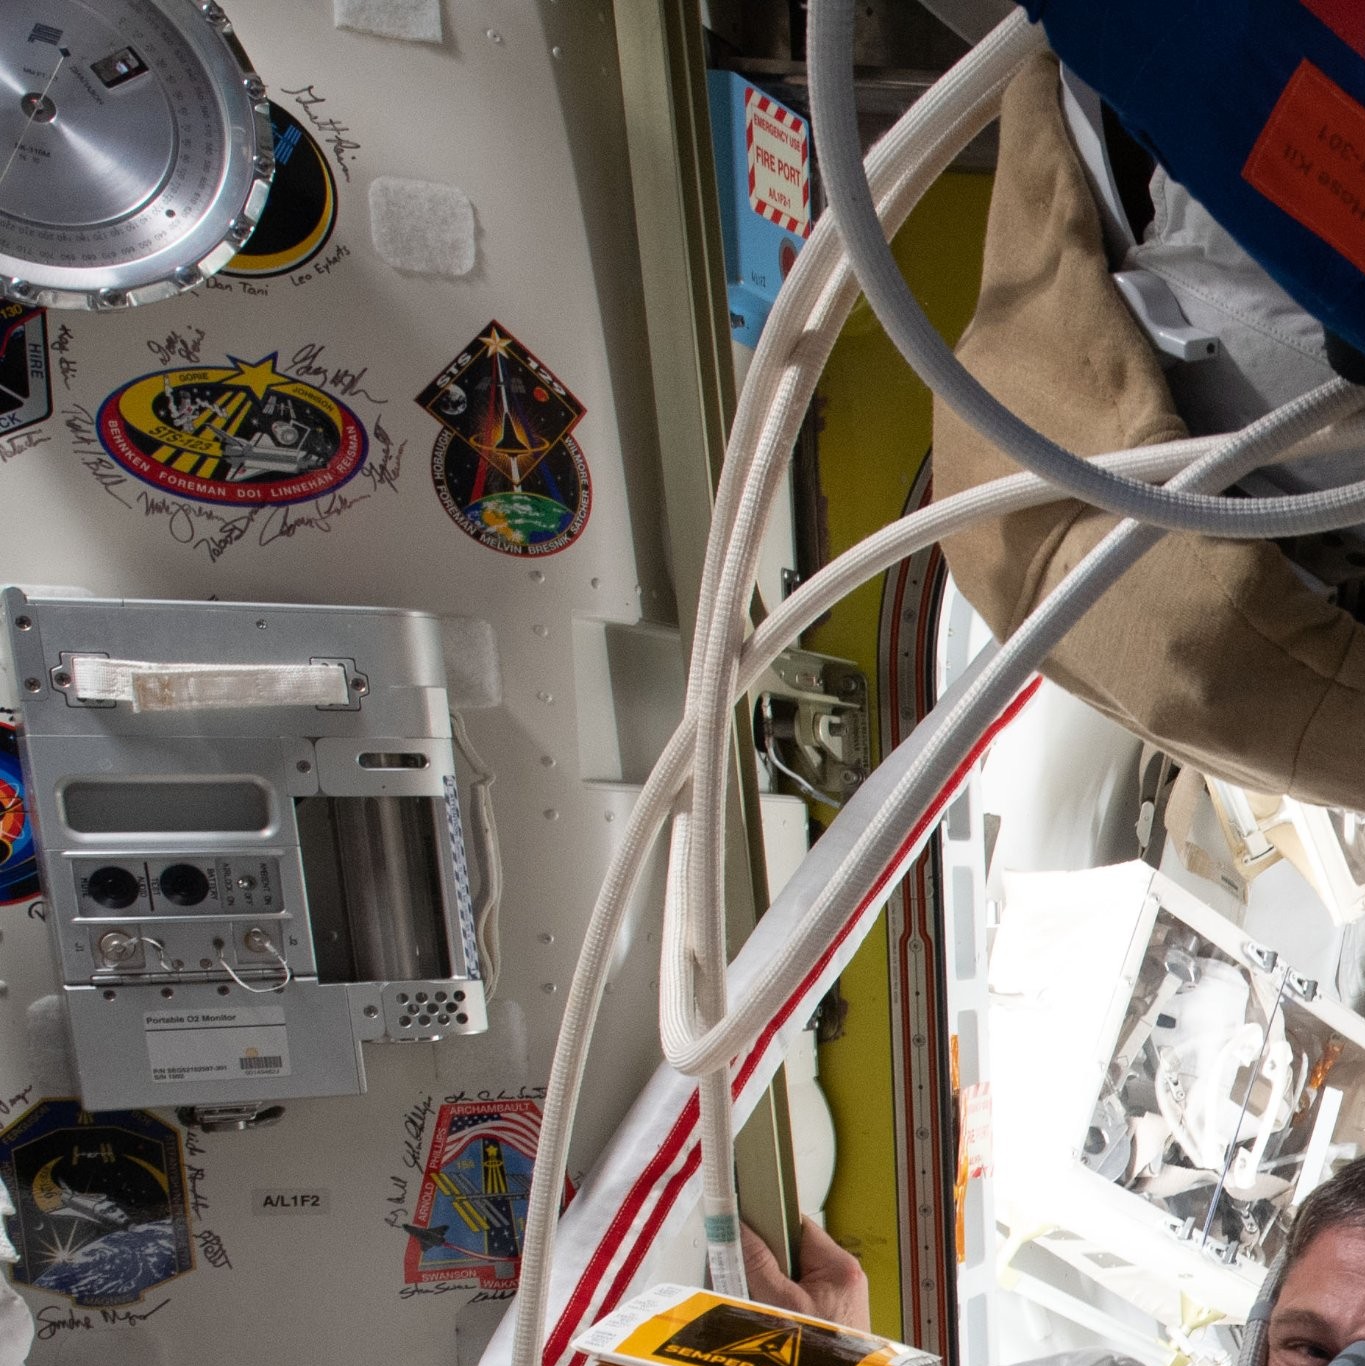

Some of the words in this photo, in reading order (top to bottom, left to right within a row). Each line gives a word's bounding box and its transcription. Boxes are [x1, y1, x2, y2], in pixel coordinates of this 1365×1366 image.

[754, 114, 788, 145] EMERGENCY
[789, 135, 800, 151] USE
[756, 146, 776, 173] FIRE
[777, 160, 800, 187] PORT
[1284, 143, 1313, 176] Kit
[206, 277, 232, 292] Dan
[239, 282, 268, 296] Tani
[291, 274, 312, 286] Leo
[28, 343, 43, 379] HIRE
[179, 371, 209, 382] GORIE
[436, 352, 472, 389] STS
[526, 357, 567, 396] 129
[292, 386, 334, 412] JOHNSON
[149, 425, 212, 451] STS-123
[107, 420, 150, 472] BEHNKEN
[158, 471, 226, 497] FOREMAN
[237, 488, 261, 498] DOI
[270, 473, 334, 497] LINNEHAN
[336, 424, 356, 474] REISMAN
[433, 430, 451, 480] HOBAUGH
[565, 436, 589, 486] WILMORE
[436, 486, 476, 535] FOREMAN
[480, 532, 522, 555] MELVIN
[528, 536, 571, 555] BRESNIK
[570, 490, 589, 535] SATCHER
[146, 1016, 184, 1024] Portable
[202, 1014, 236, 1022] Monitor
[450, 1102, 530, 1115] ARCHAMBAULT
[418, 1183, 434, 1222] ARNOLD
[430, 1128, 447, 1169] PHILLIPS
[263, 1194, 321, 1208] A/L1F2
[422, 1269, 477, 1282] SWANSON
